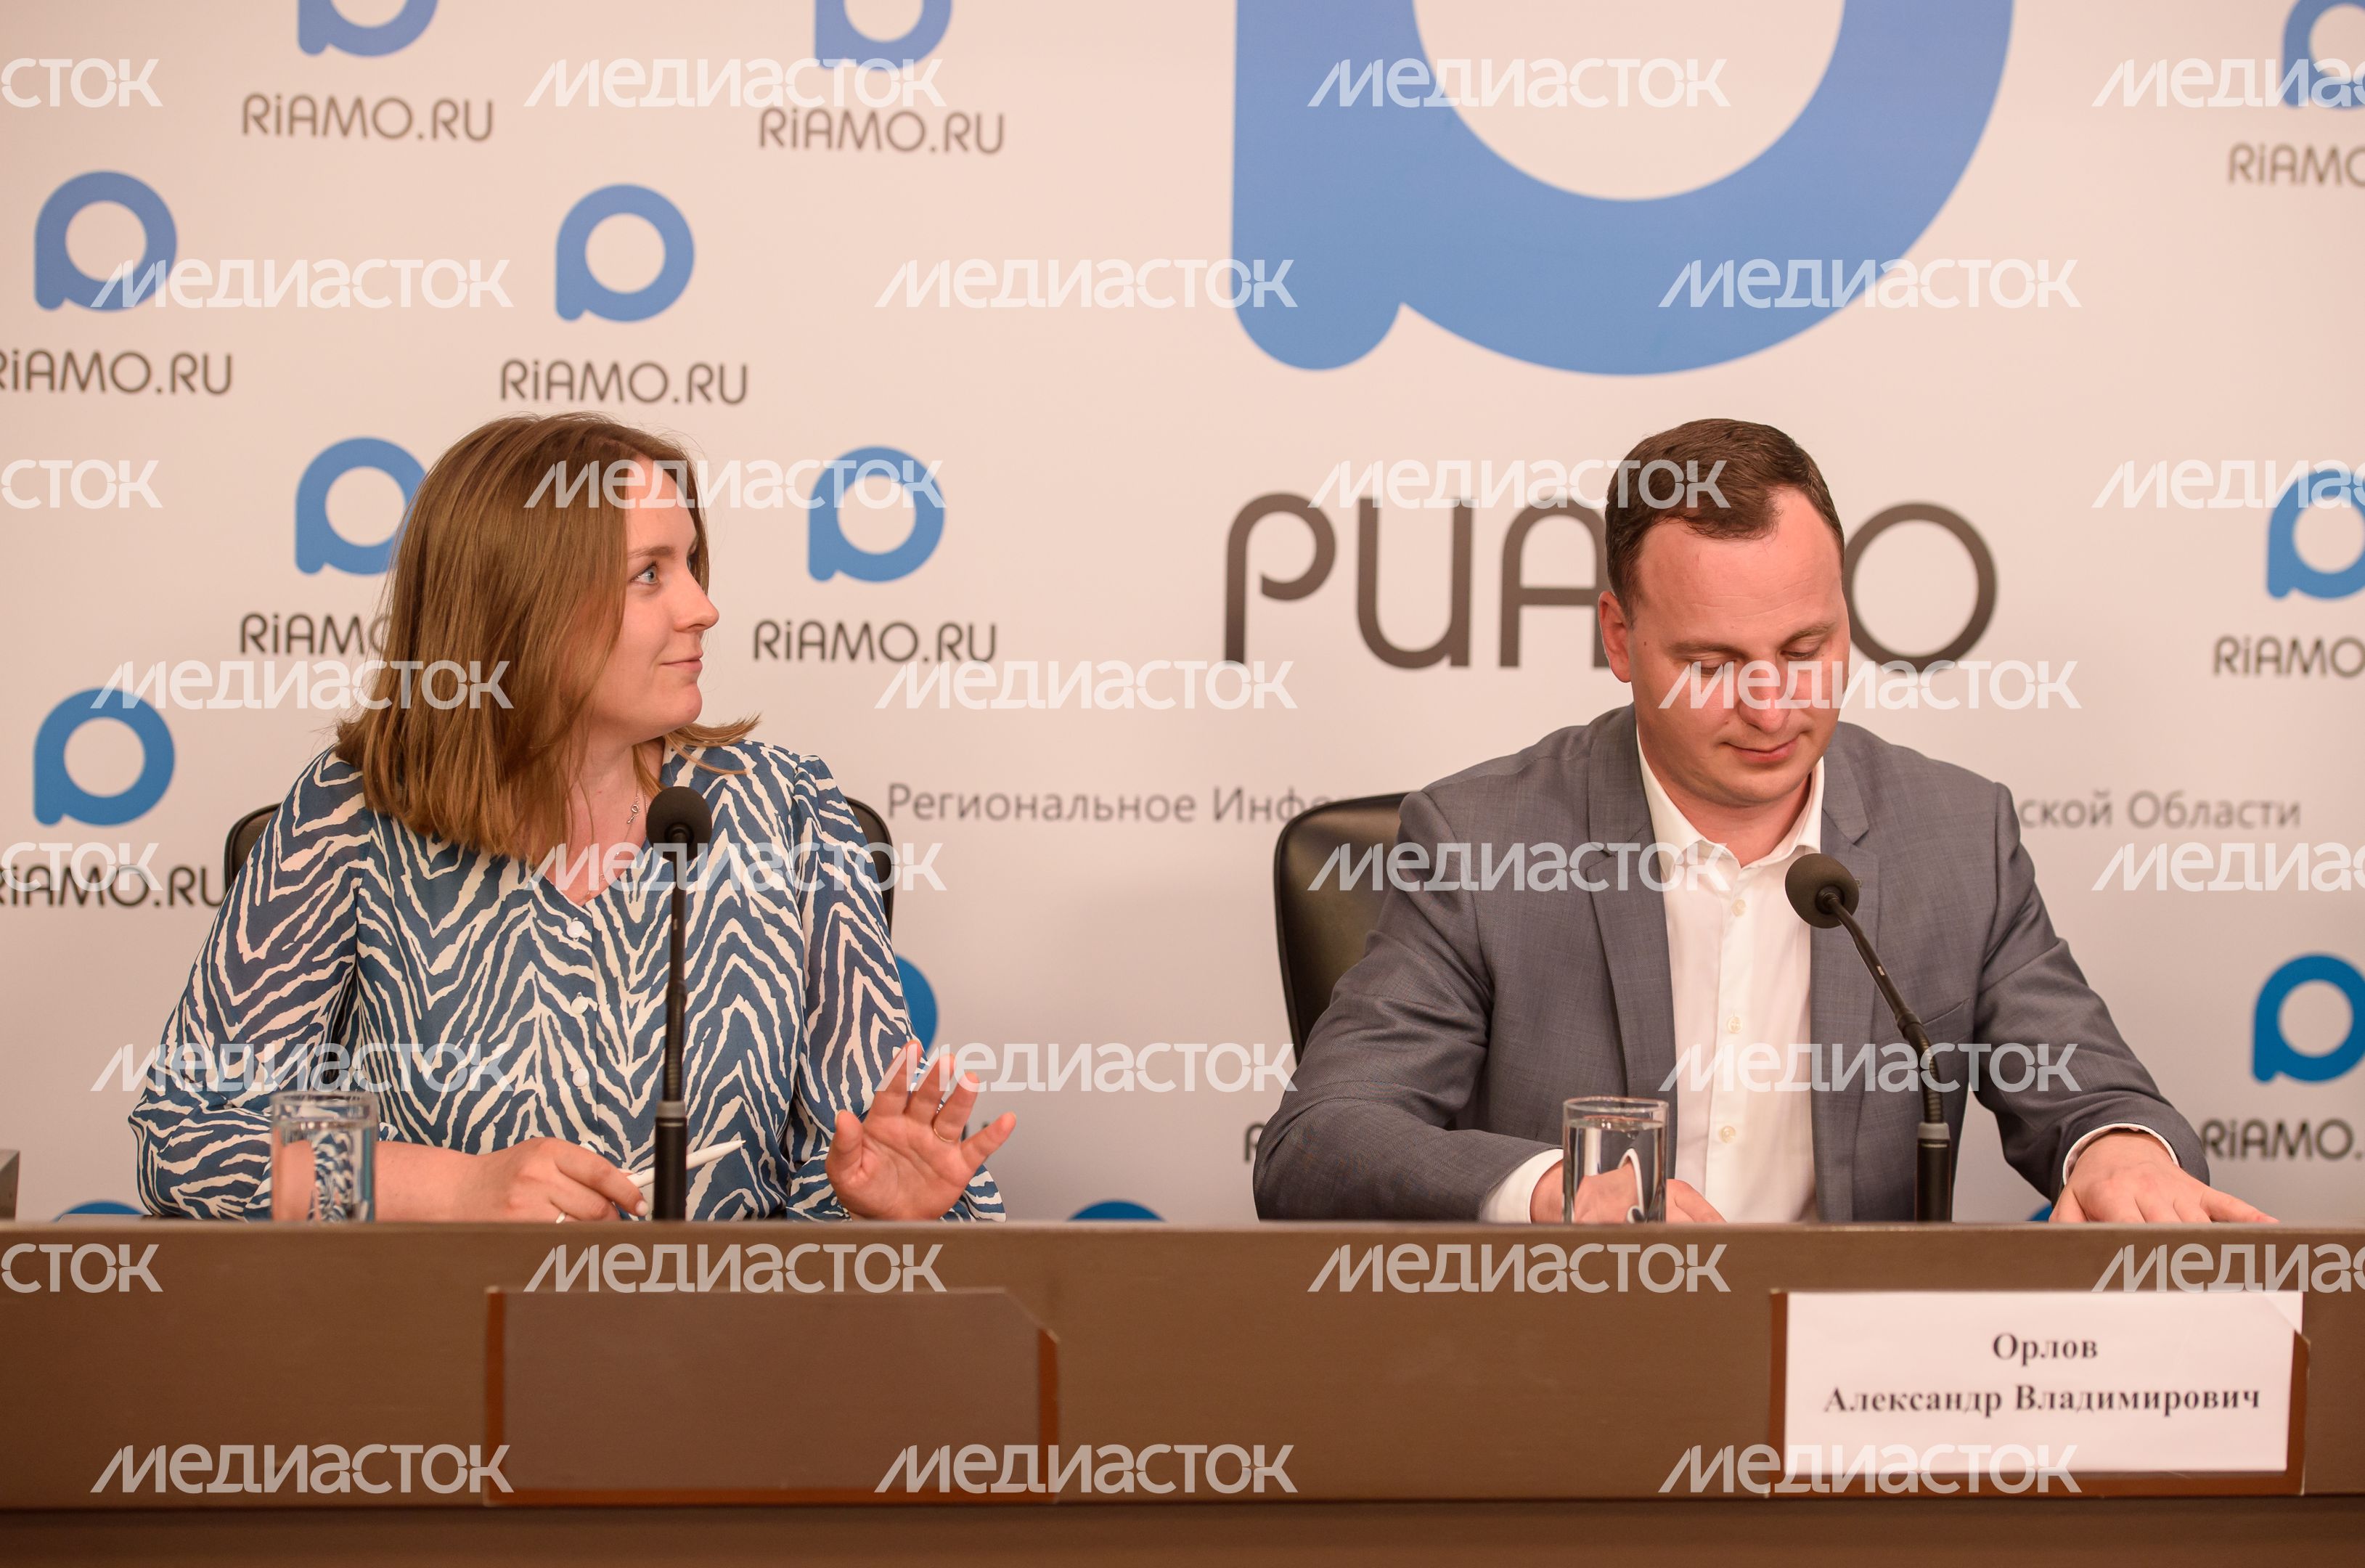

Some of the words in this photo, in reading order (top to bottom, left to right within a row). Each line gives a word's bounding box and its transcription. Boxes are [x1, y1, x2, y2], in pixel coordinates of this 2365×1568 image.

[242, 93, 494, 142] RiAMO.RU
[759, 107, 1005, 154] RiAMO.RU
[500, 359, 748, 404] RiAMO.RU
[753, 618, 997, 663] RiAMO.RU
[888, 783, 1197, 822] Региональное
[2128, 789, 2301, 829] Области
[1993, 1333, 2099, 1366] Орлов
[1823, 1387, 2003, 1418] Александр
[2015, 1384, 2260, 1417] Владимирович
